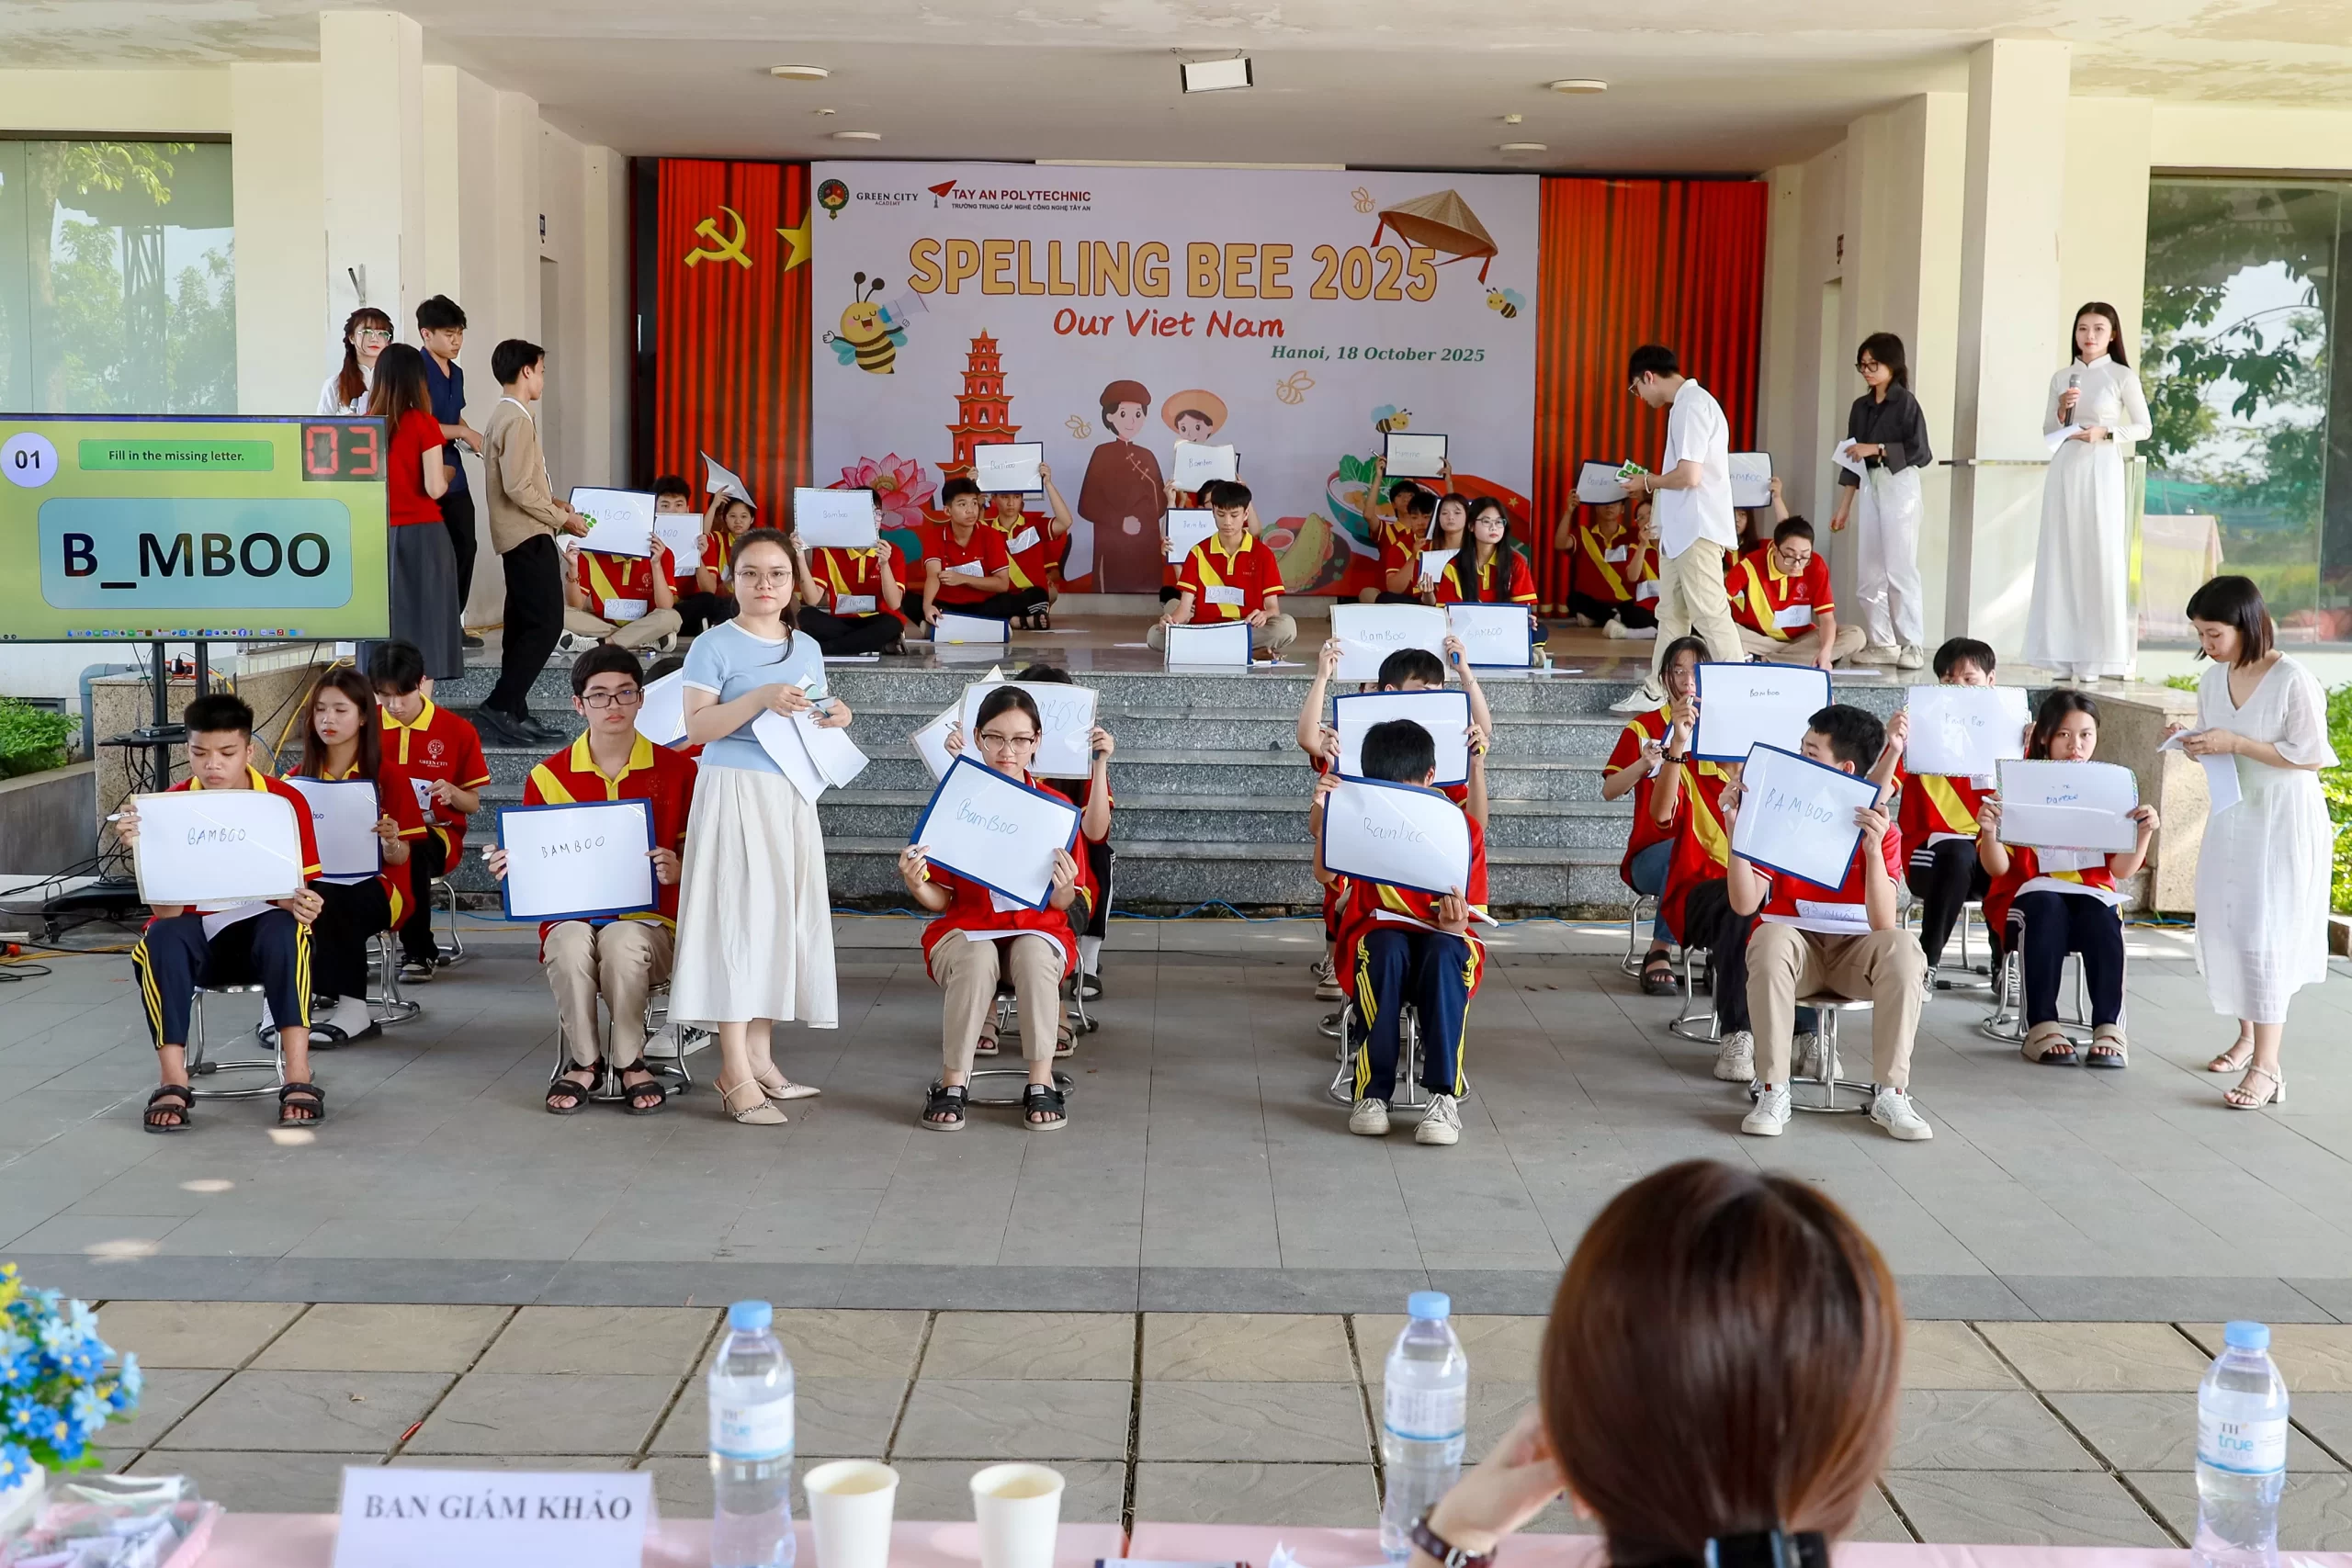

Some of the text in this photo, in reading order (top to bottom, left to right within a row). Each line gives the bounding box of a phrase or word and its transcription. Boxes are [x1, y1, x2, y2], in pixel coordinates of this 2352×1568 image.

[856, 192, 919, 201] GREEN CITY
[952, 189, 1091, 202] TAY AN POLYTECHNIC
[907, 239, 1438, 302] SPELLING BEE 2025
[1054, 308, 1284, 338] Our Viet Nam
[1272, 344, 1486, 363] Hanoi, 18 October 2025
[15, 450, 41, 469] 01
[108, 450, 244, 464] Fill in the missing letter.
[306, 425, 379, 476] 03
[1728, 472, 1762, 482] AMBOO
[63, 533, 331, 590] B_MBOO
[1765, 787, 1834, 824] BAMBOO
[187, 828, 246, 846] BAMBOO
[542, 835, 605, 859] BAMBOO
[2219, 1422, 2240, 1436] TH
[2218, 1434, 2254, 1451] true
[365, 1488, 632, 1521] BAN GIÁM KHẢO
